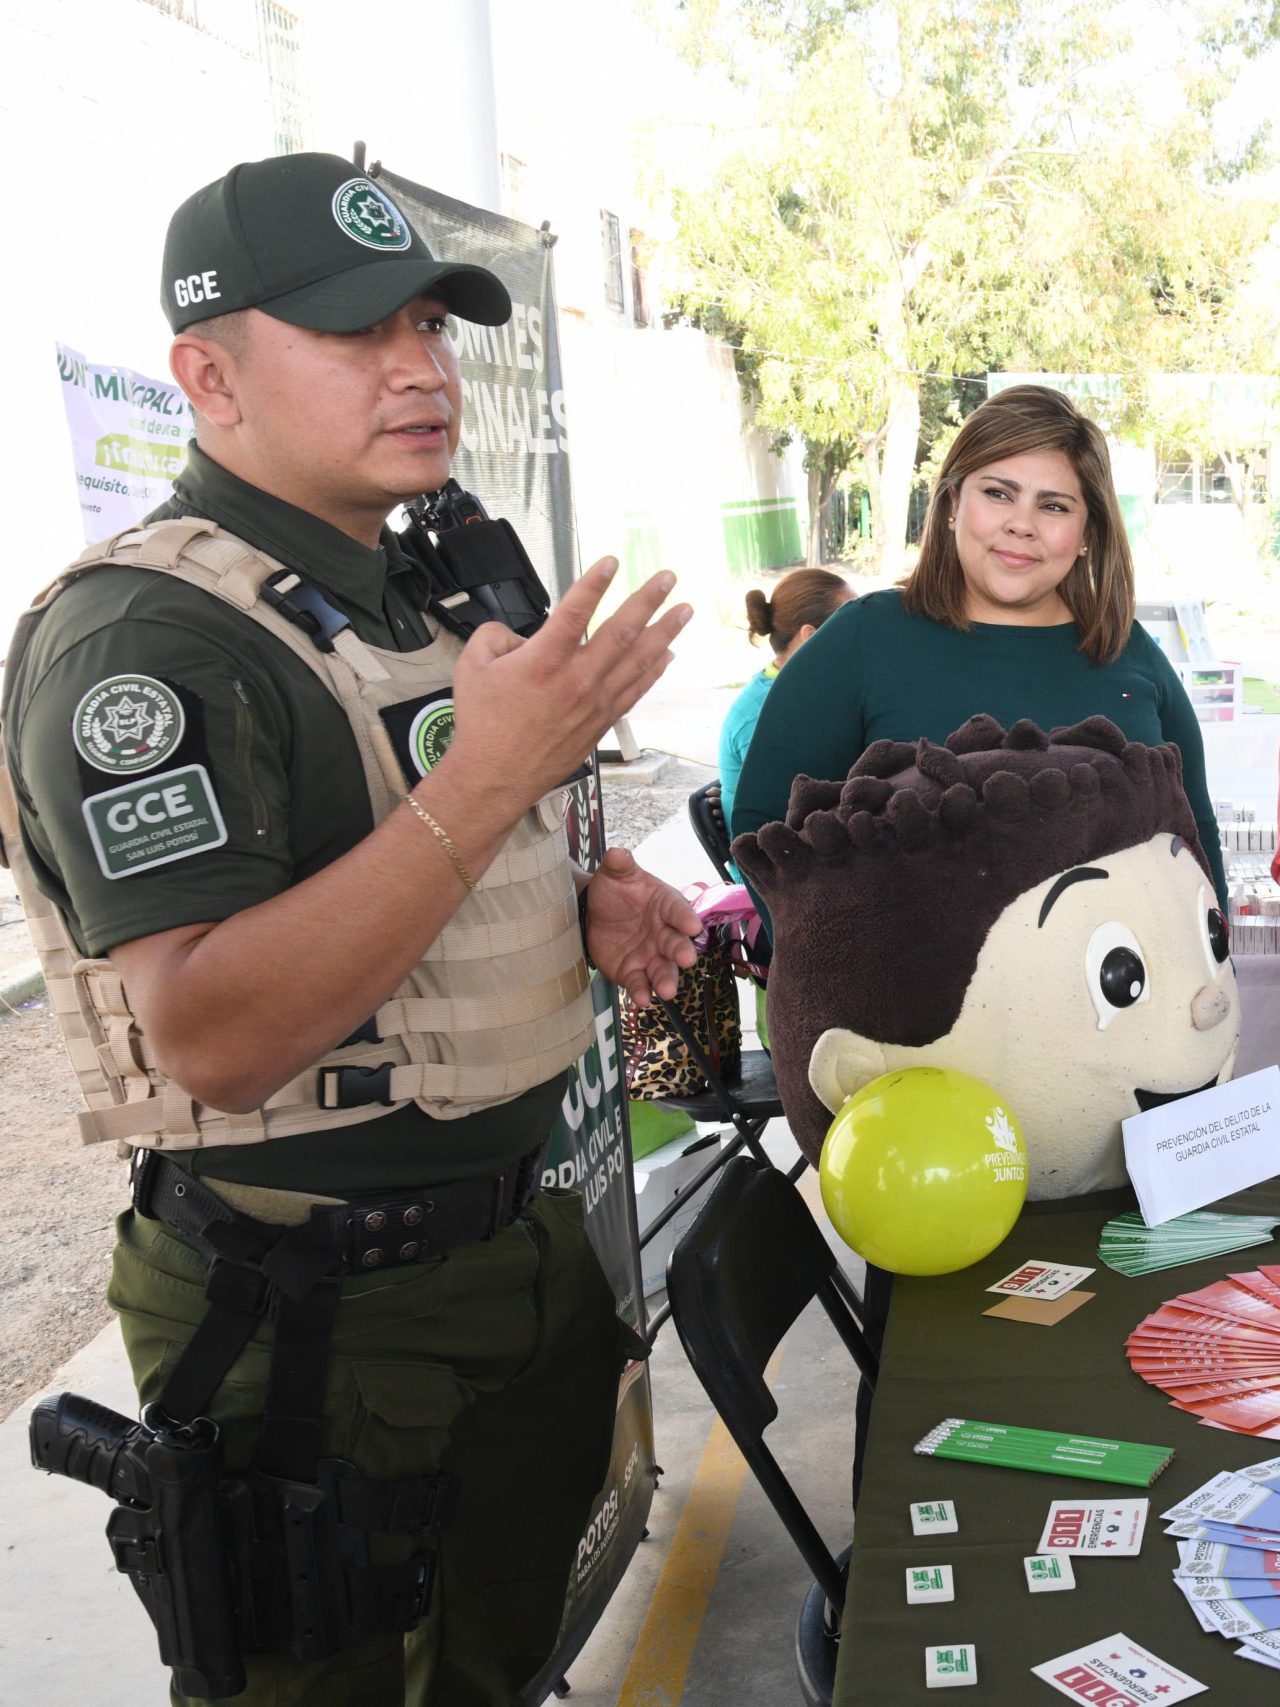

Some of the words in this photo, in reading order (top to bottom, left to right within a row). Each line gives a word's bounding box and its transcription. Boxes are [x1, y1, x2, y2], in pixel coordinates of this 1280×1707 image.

[340, 189, 356, 224] GUARDIA
[174, 270, 222, 308] GCE
[82, 691, 110, 737] GUARDIA
[110, 684, 141, 694] CIVIL
[142, 687, 174, 726] ESTATAL
[107, 783, 194, 833] GCE
[109, 835, 150, 854] GUARDIA
[150, 828, 173, 841] CIVIL
[173, 817, 209, 833] ESTATAL
[126, 849, 145, 861] SAN
[145, 842, 166, 855] LUIS
[166, 830, 199, 848] POTOSÍ
[588, 1117, 615, 1161] CIVIL
[1156, 1125, 1208, 1152] PREVENCIÓN
[1209, 1120, 1224, 1134] DEL
[1224, 1111, 1250, 1128] DELITO
[1250, 1105, 1260, 1118] DE
[1261, 1102, 1272, 1113] LA
[1175, 1141, 1211, 1162] GUARDIA
[1211, 1136, 1230, 1149] CIVIL
[1230, 1122, 1261, 1142] ESTATAL
[585, 1165, 608, 1215] LUIS
[993, 1167, 1025, 1182] JUNTOS
[1002, 1268, 1043, 1290] 911
[1052, 1513, 1081, 1546] 911
[1088, 1509, 1105, 1549] EMERGENCIAS
[577, 1562, 592, 1584] PARA
[591, 1546, 600, 1565] LOS
[1089, 1658, 1158, 1701] EMERGENCIAS
